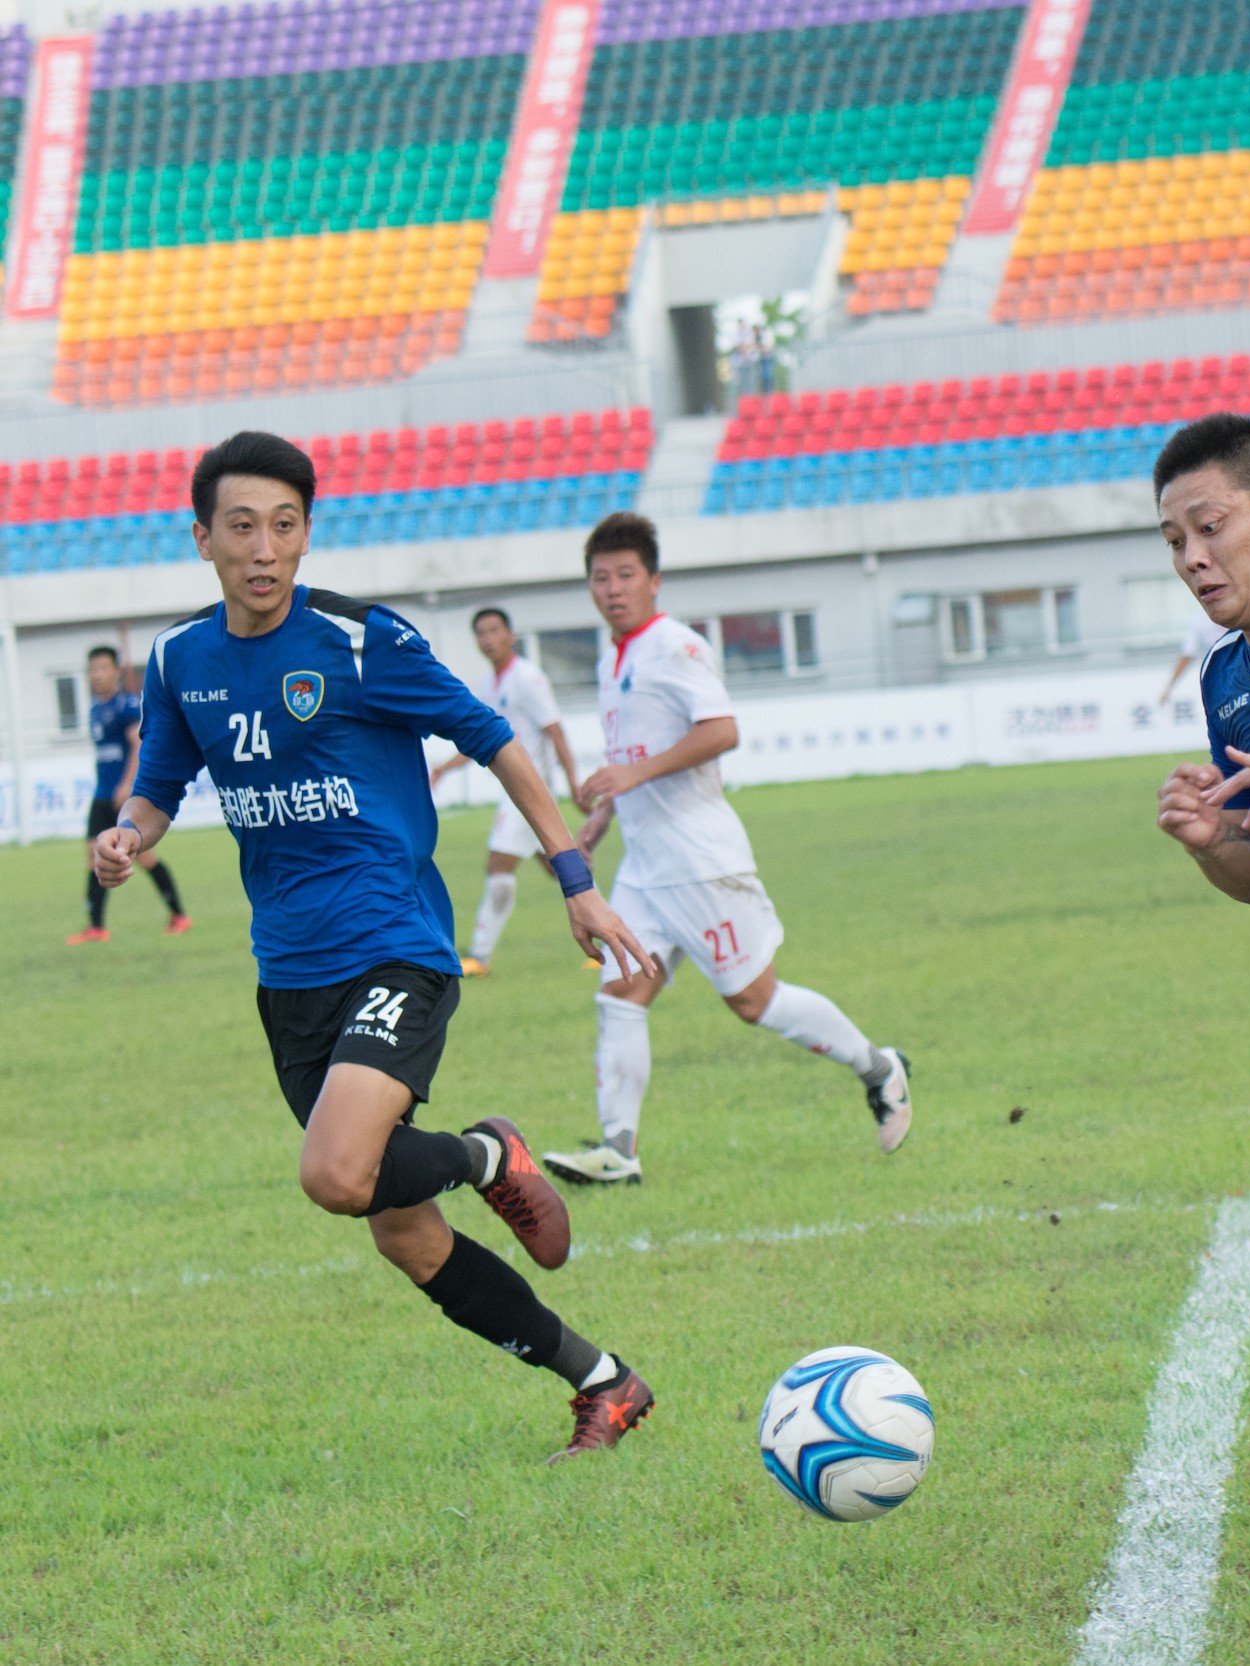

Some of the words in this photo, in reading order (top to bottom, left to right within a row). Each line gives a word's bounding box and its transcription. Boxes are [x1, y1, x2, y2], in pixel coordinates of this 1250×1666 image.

[182, 689, 229, 703] KELME
[1217, 692, 1250, 720] KELME
[228, 711, 272, 762] 24
[704, 921, 739, 963] 27
[355, 986, 409, 1031] 24
[344, 1025, 399, 1047] KELME
